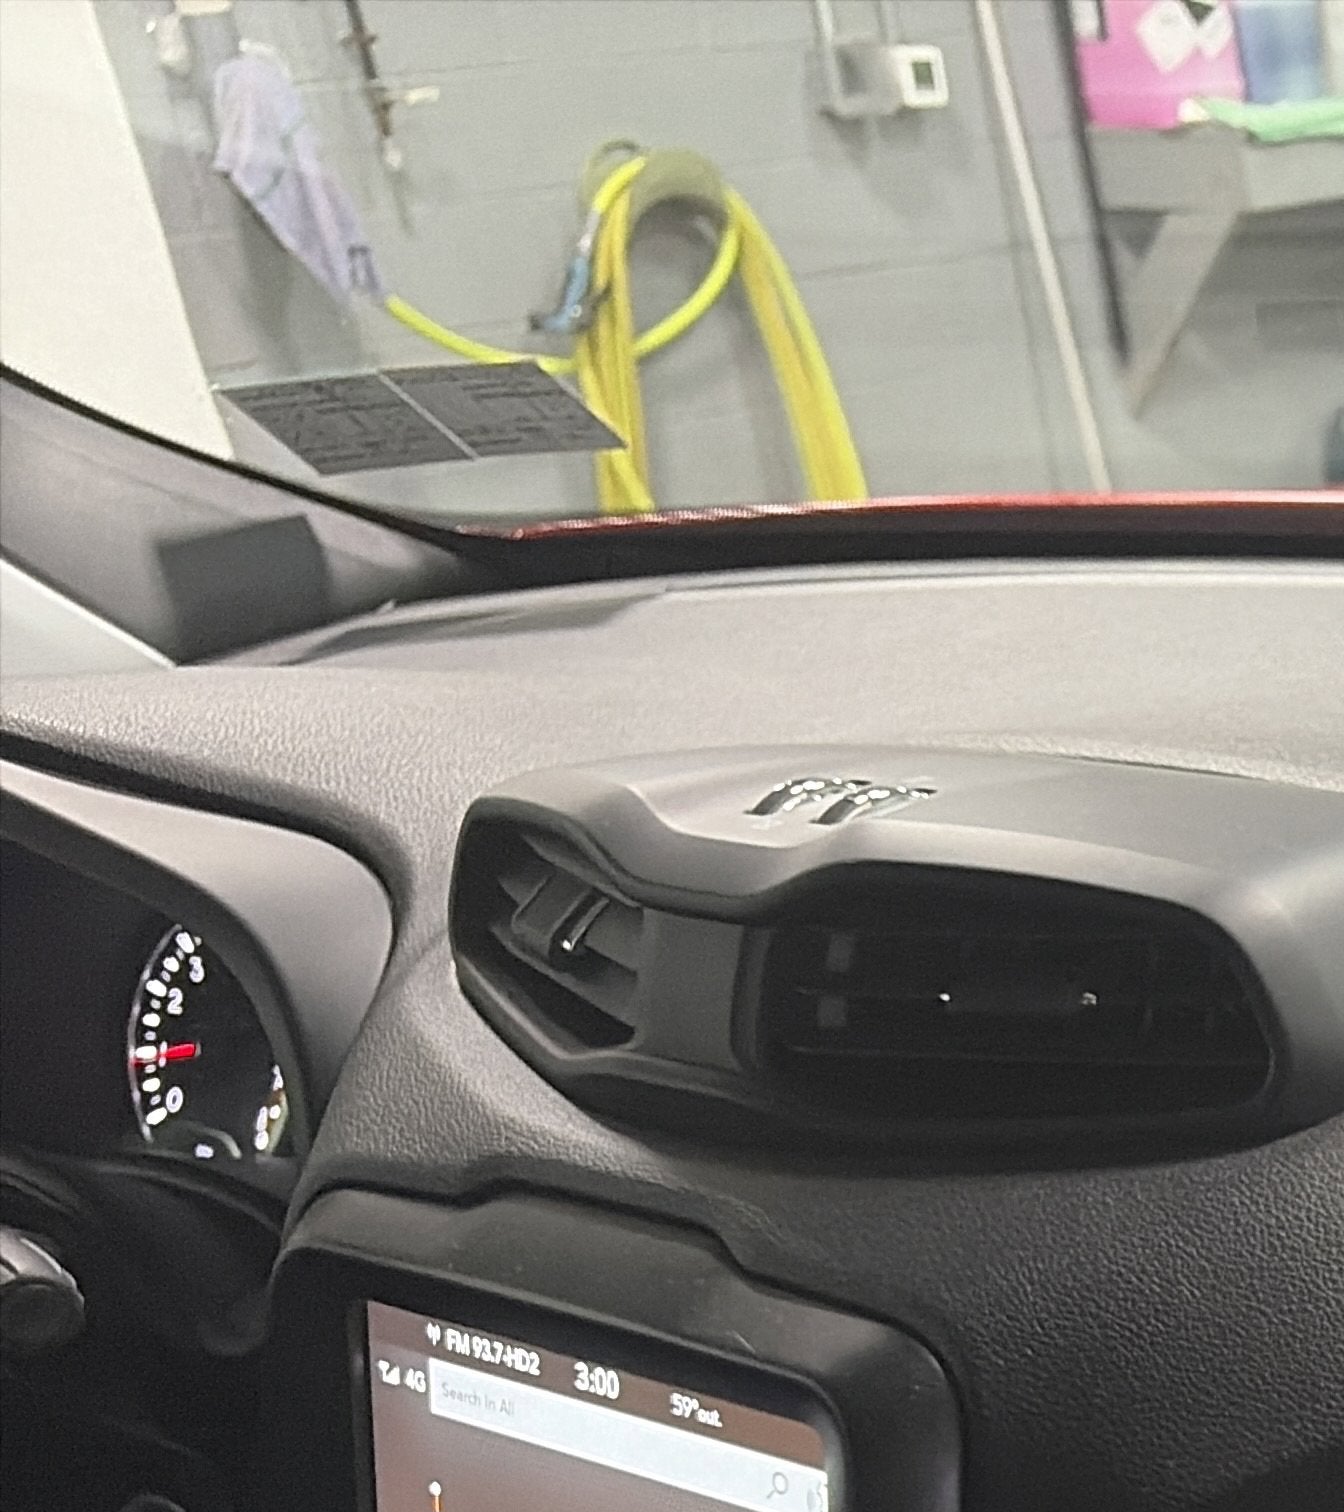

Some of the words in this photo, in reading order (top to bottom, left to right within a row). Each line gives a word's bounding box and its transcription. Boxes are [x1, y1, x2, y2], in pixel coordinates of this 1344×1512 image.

[188, 955, 205, 984] 3
[166, 987, 184, 1016] 2
[165, 1086, 184, 1114] 0
[446, 1328, 470, 1356] FM
[404, 1368, 427, 1393] 4G
[573, 1361, 620, 1400] 3:00
[441, 1381, 483, 1409] Search
[499, 1398, 516, 1416] All
